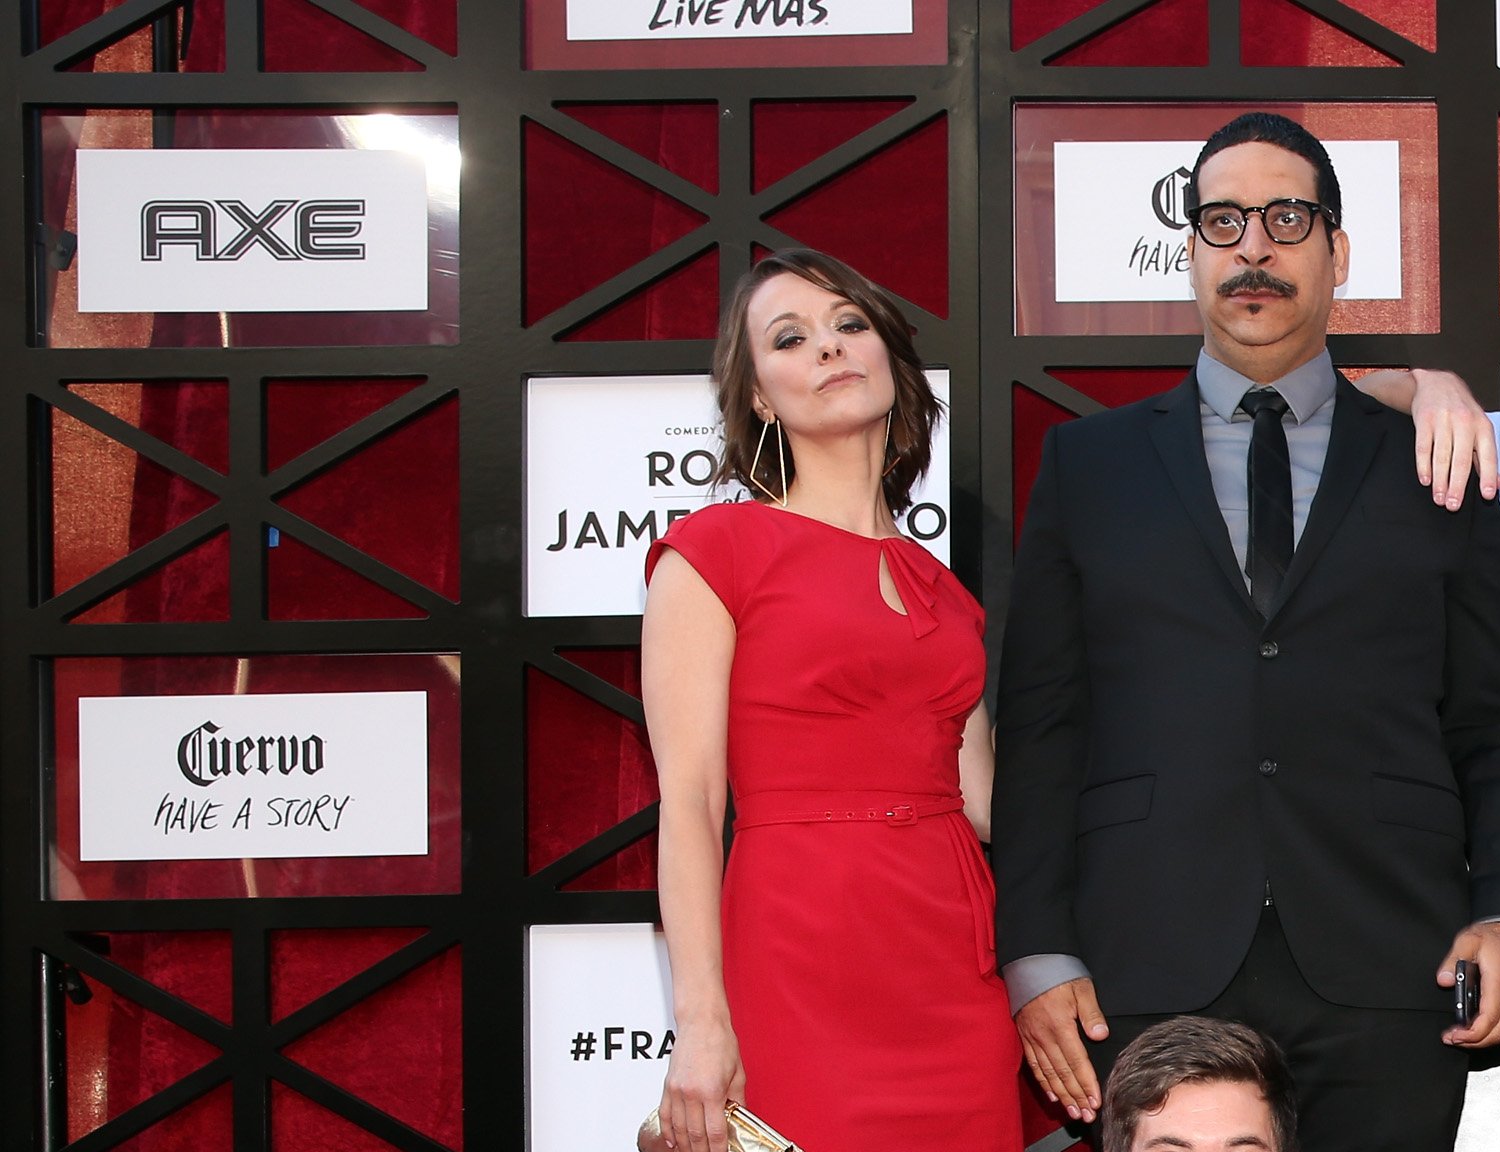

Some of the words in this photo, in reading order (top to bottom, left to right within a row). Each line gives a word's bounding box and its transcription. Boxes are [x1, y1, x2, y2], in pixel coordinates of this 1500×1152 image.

[140, 199, 366, 262] AXE
[665, 426, 716, 436] COMEDY
[177, 720, 324, 787] Cuervo
[232, 797, 252, 830] A
[266, 794, 350, 832] STORY
[570, 1026, 677, 1061] #FRA
